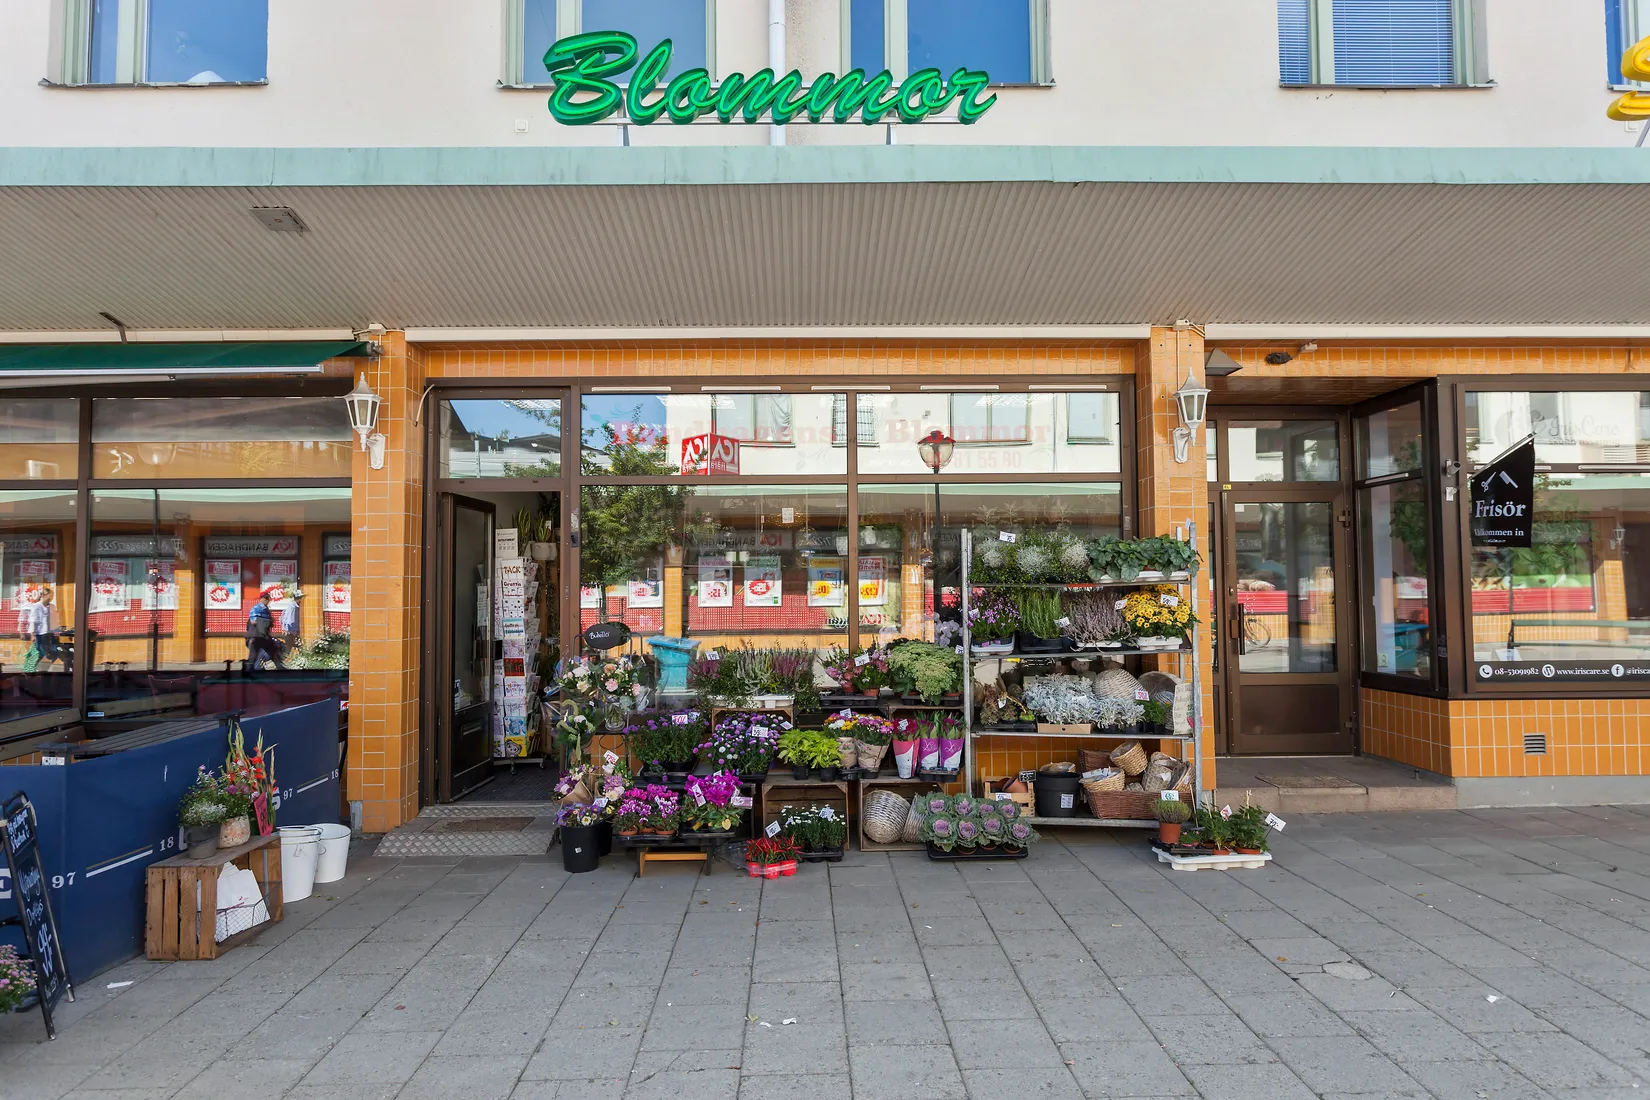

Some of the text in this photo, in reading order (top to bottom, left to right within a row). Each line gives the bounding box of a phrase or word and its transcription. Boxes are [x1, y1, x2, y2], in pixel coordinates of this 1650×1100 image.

[542, 30, 997, 126] Blommor
[1475, 499, 1527, 518] Frisör
[1515, 528, 1525, 536] in
[1556, 667, 1610, 675] www.iriscare.se
[330, 768, 340, 780] 18
[283, 787, 294, 801] 97
[159, 836, 175, 852] 18
[52, 871, 78, 889] 97
